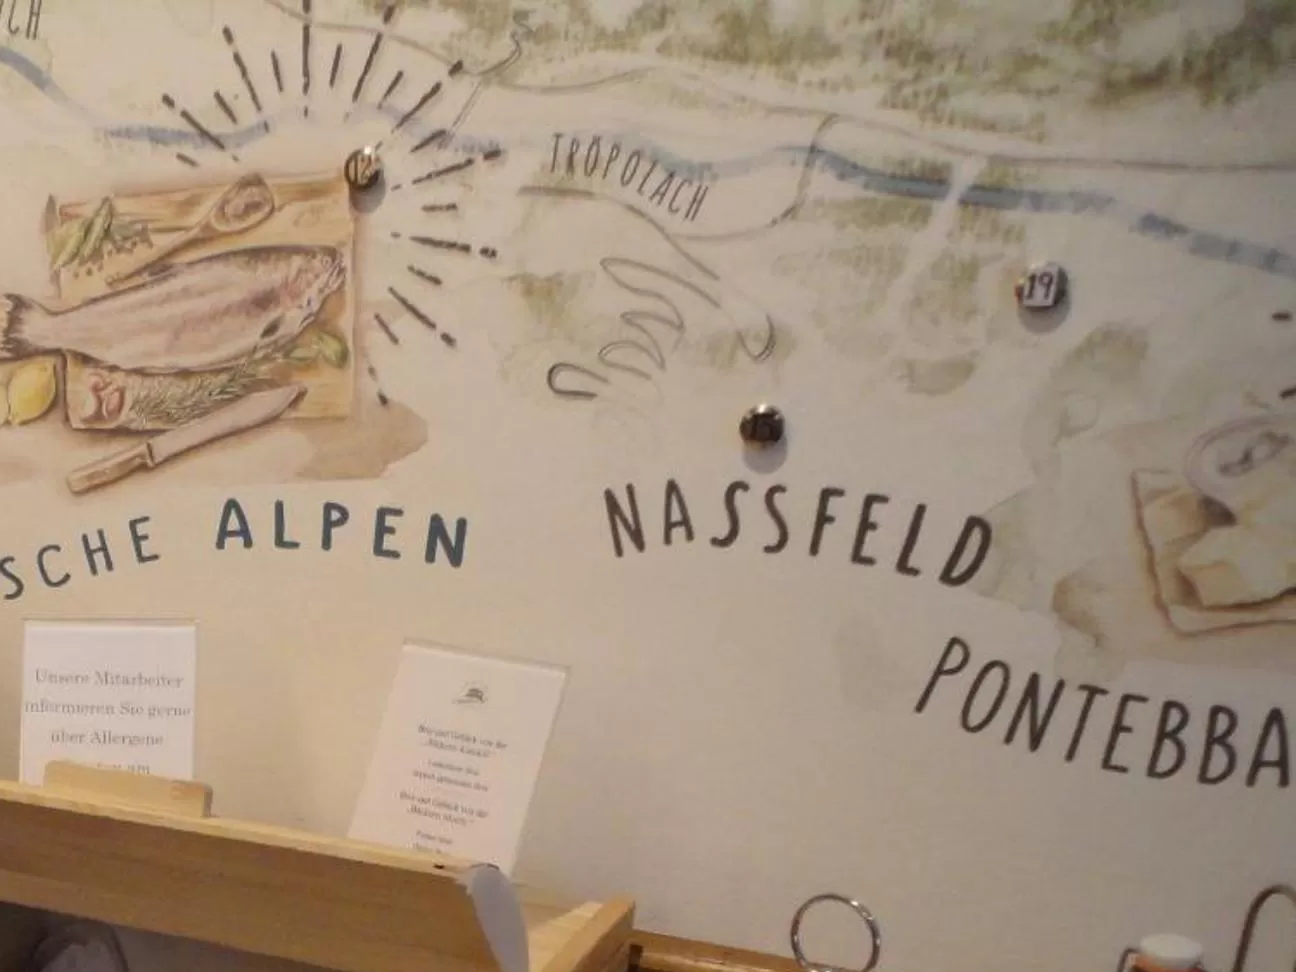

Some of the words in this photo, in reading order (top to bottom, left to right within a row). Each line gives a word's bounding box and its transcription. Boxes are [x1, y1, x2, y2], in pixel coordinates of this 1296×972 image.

[1026, 271, 1055, 299] 19
[215, 498, 468, 568] ALPEN
[604, 478, 993, 588] NASSFELD
[913, 636, 1292, 789] PONTEBBA
